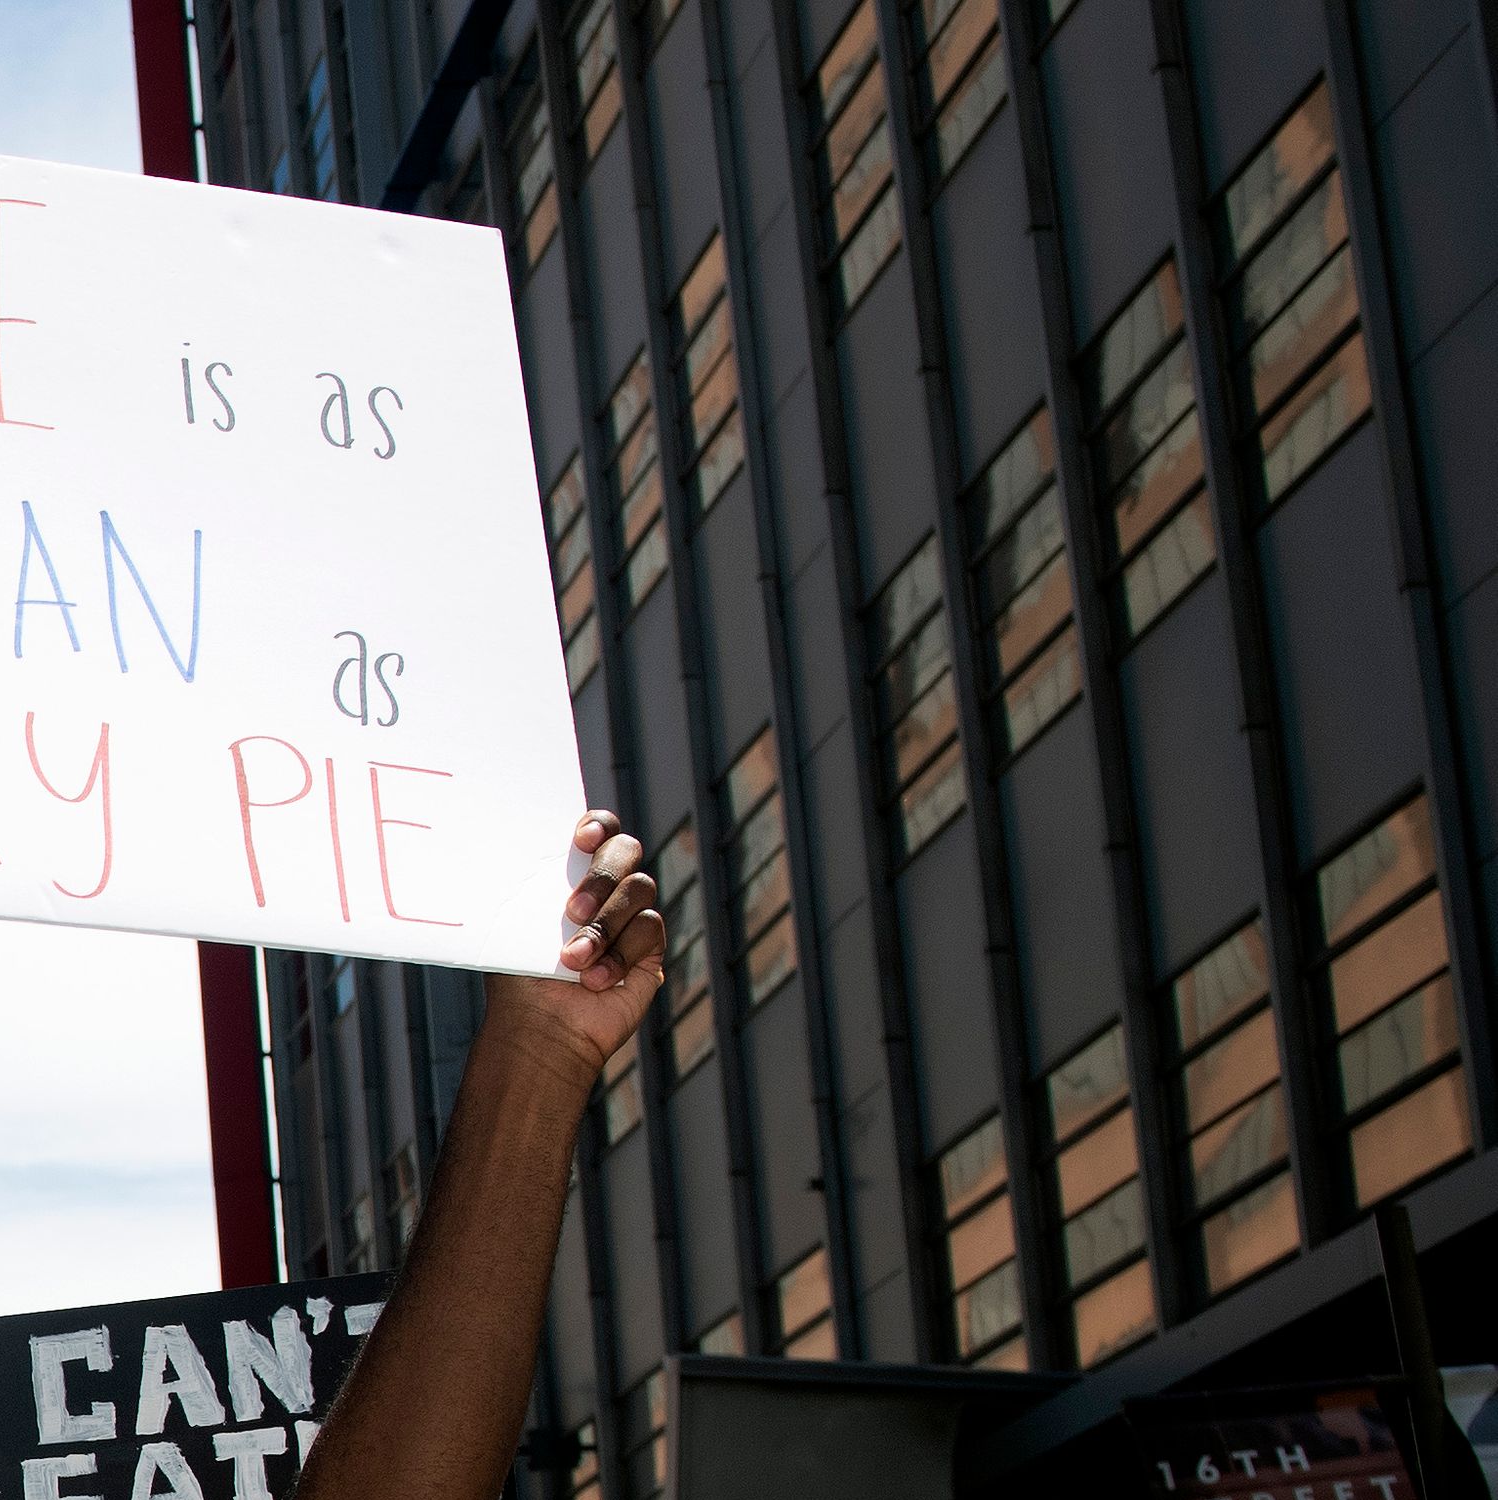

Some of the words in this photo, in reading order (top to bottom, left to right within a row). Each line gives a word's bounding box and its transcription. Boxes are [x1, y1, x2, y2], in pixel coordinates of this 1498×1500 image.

[181, 342, 236, 432] is
[315, 372, 403, 460] as
[332, 629, 404, 726] as
[227, 734, 464, 926] PIE
[1156, 1444, 1311, 1491] 16TH
